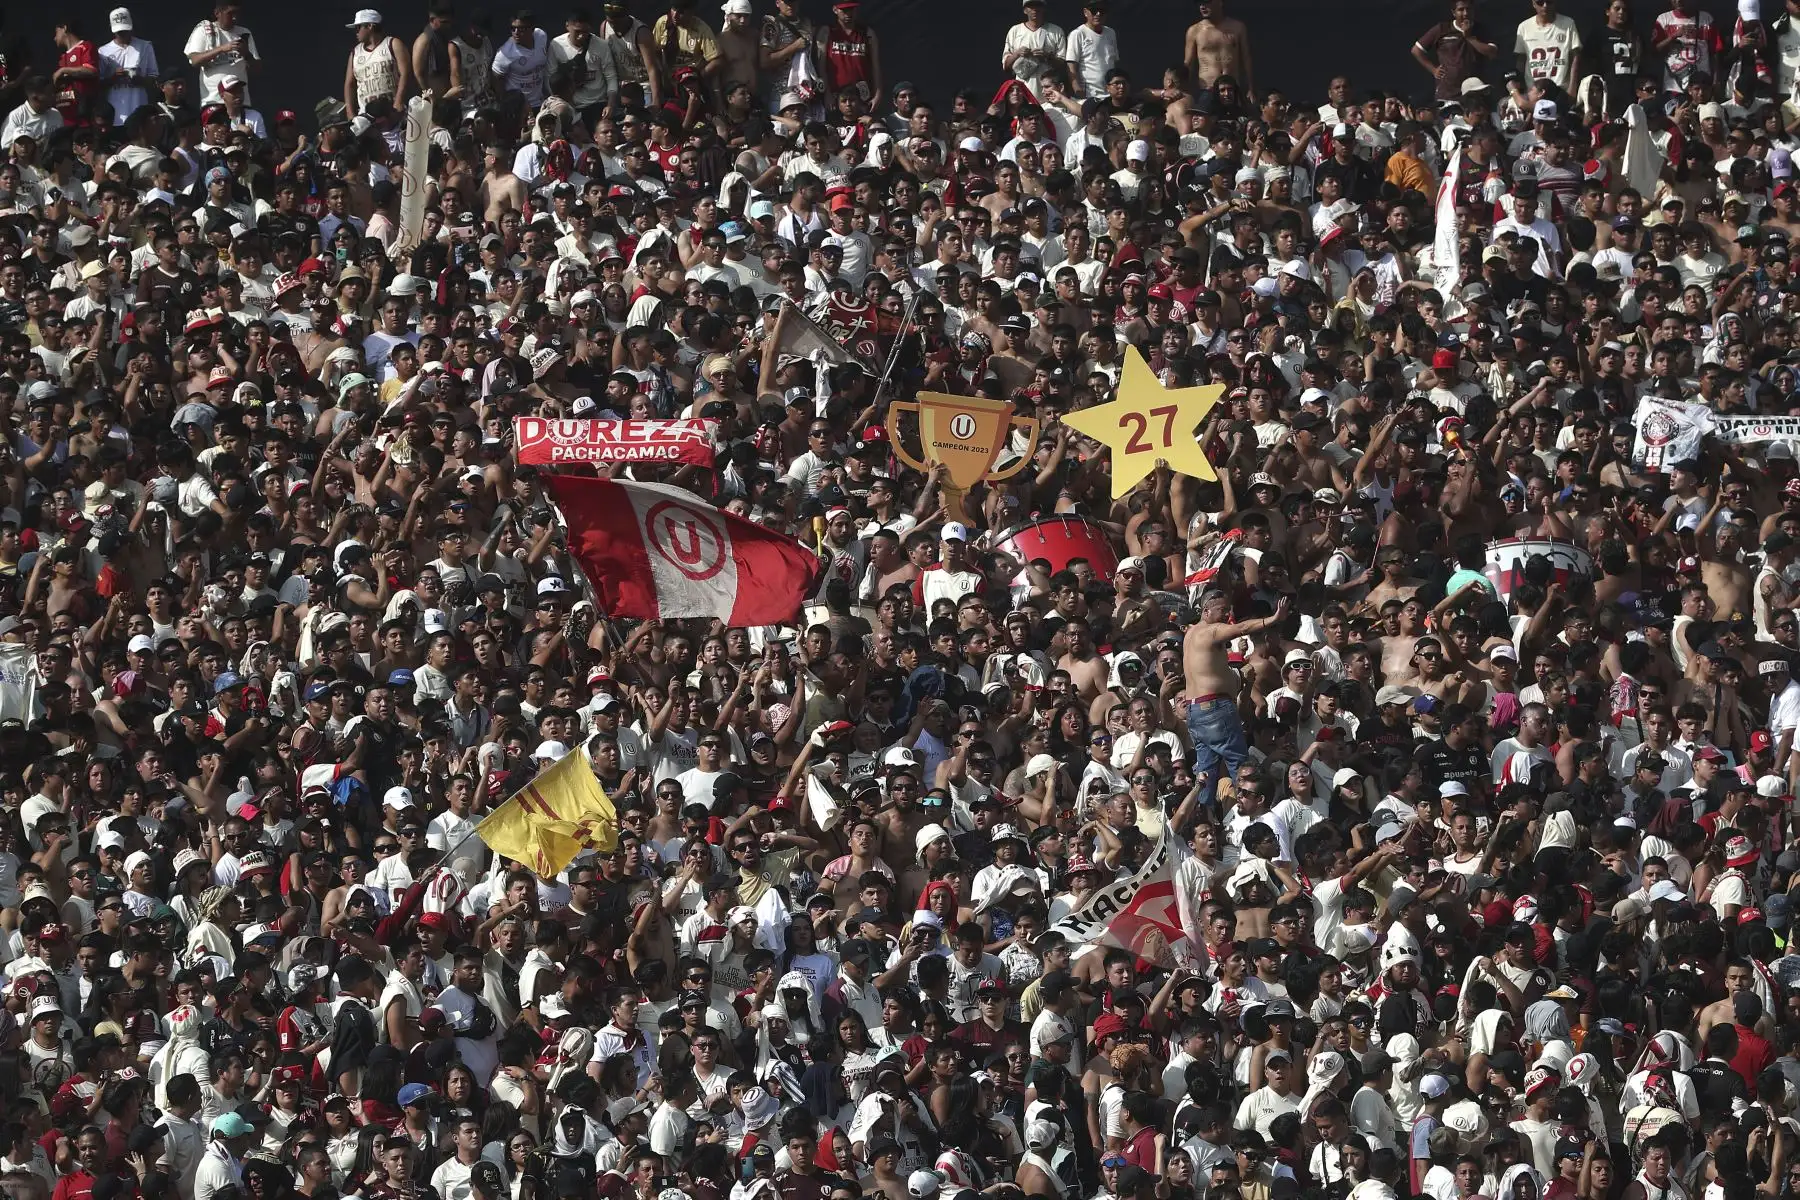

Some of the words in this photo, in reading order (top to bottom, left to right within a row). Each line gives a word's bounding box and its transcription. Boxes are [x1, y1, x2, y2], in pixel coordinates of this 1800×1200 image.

[1531, 46, 1561, 78] 27
[520, 418, 709, 446] DUREZA
[954, 416, 971, 436] U
[1118, 404, 1179, 455] 27
[551, 446, 680, 461] PACHACAMAC
[971, 446, 989, 454] 2023
[663, 516, 702, 565] U
